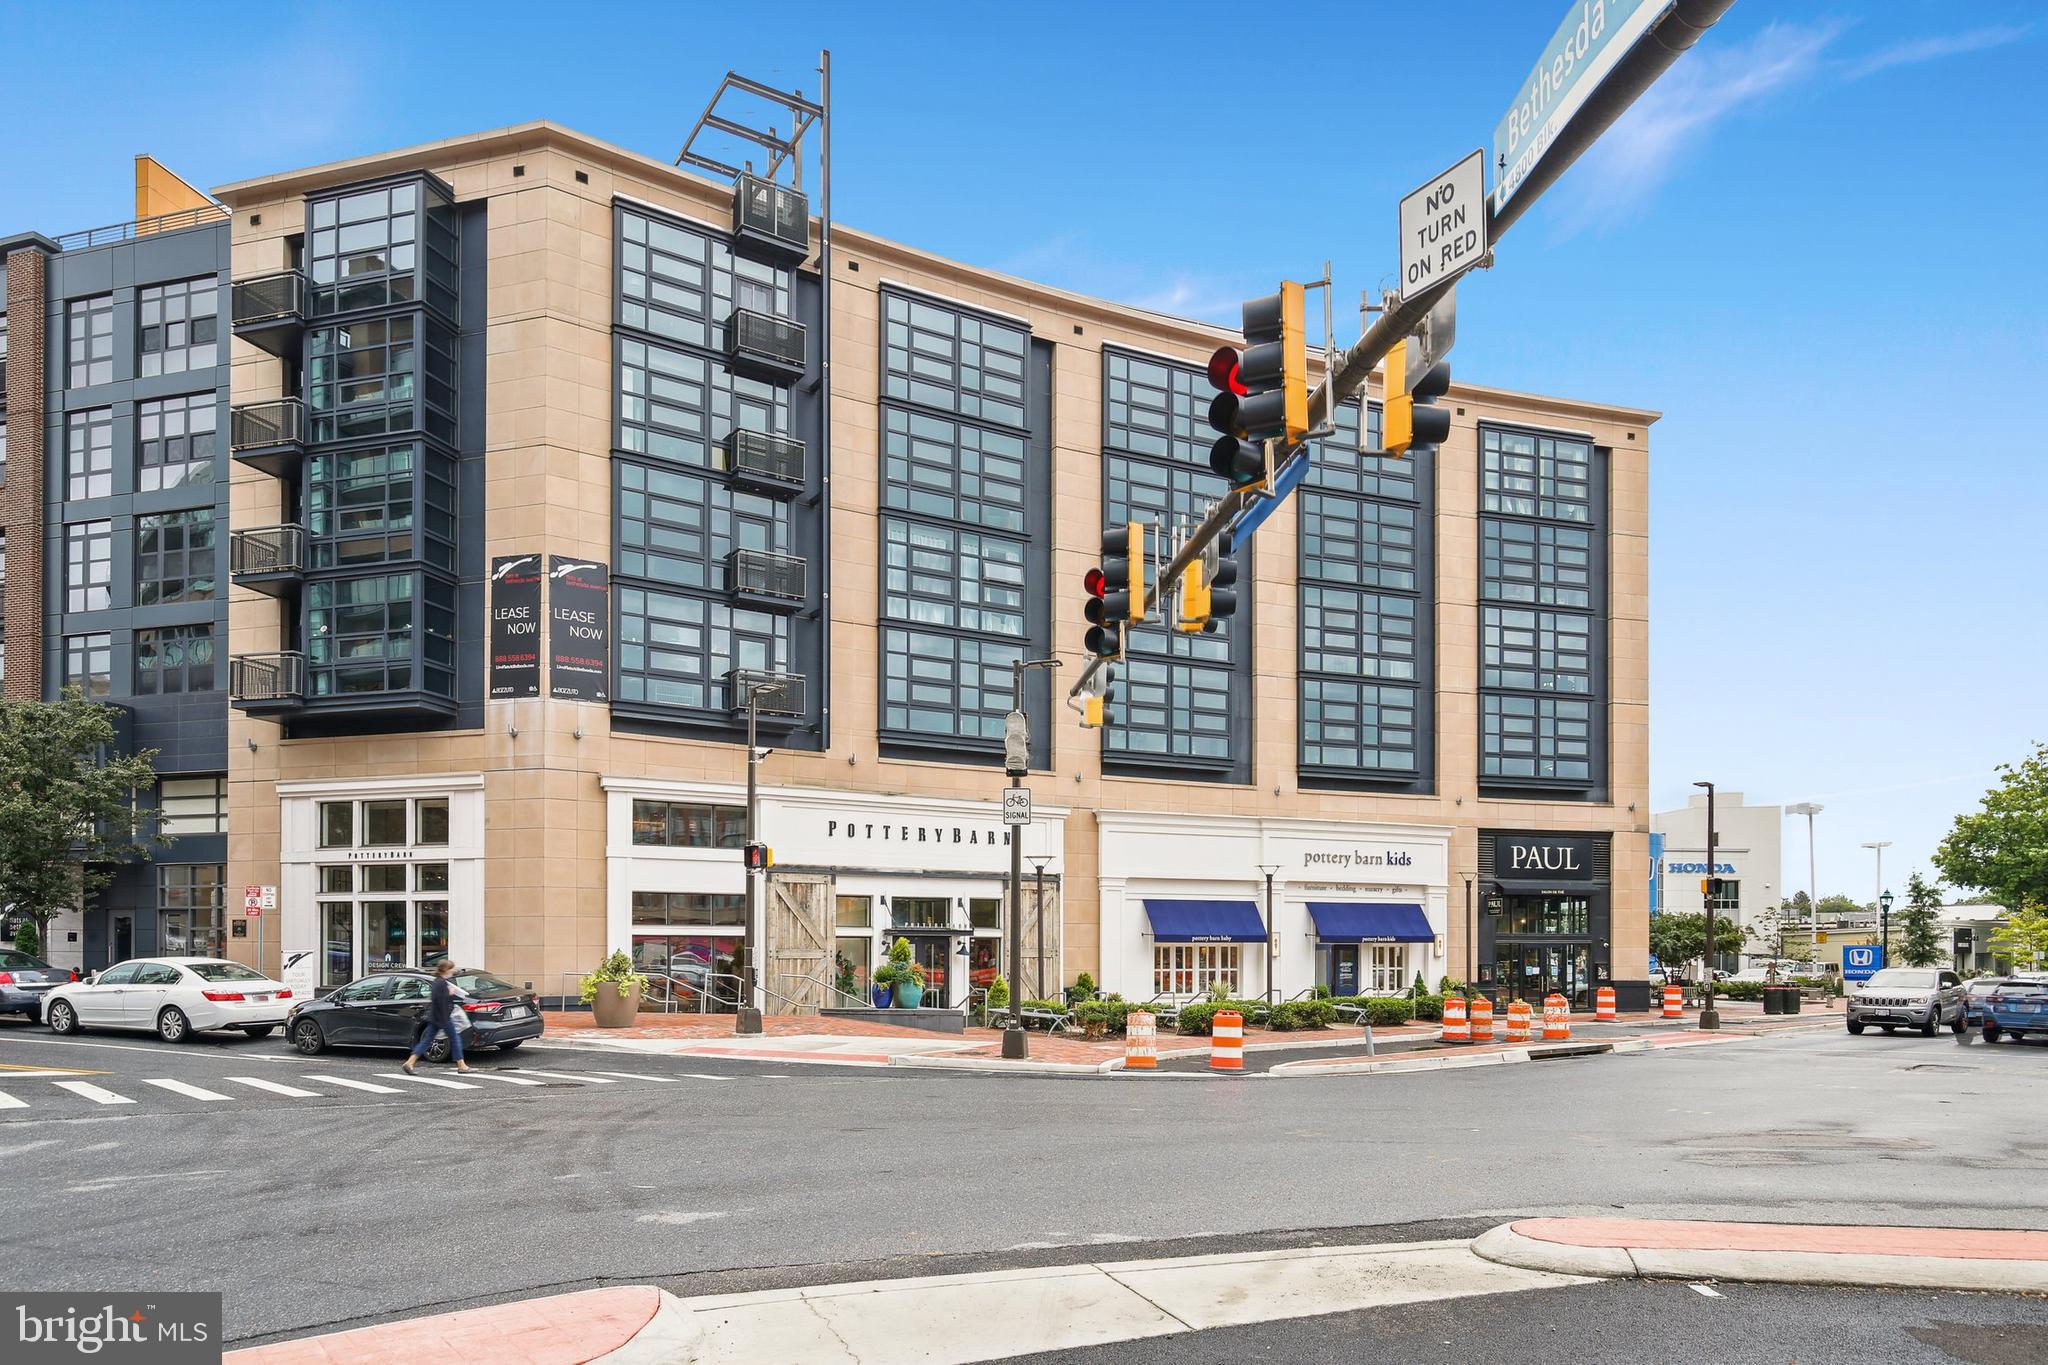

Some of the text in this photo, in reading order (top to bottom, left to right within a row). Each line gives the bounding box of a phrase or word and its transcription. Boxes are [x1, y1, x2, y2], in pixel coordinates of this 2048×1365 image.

[1508, 0, 1605, 155] Bethesda
[1508, 147, 1534, 190] 4800
[1426, 183, 1455, 216] NO
[1417, 204, 1465, 248] TURN
[1408, 229, 1477, 284] ON RED
[495, 606, 530, 620] LEASE
[554, 607, 596, 624] LEASE
[507, 622, 536, 635] NOW
[569, 625, 603, 640] NOW
[1006, 812, 1028, 820] SIGNAL
[1304, 850, 1412, 868] pottery barn kids
[1510, 845, 1580, 870] PAUL
[1668, 863, 1736, 874] HONDA
